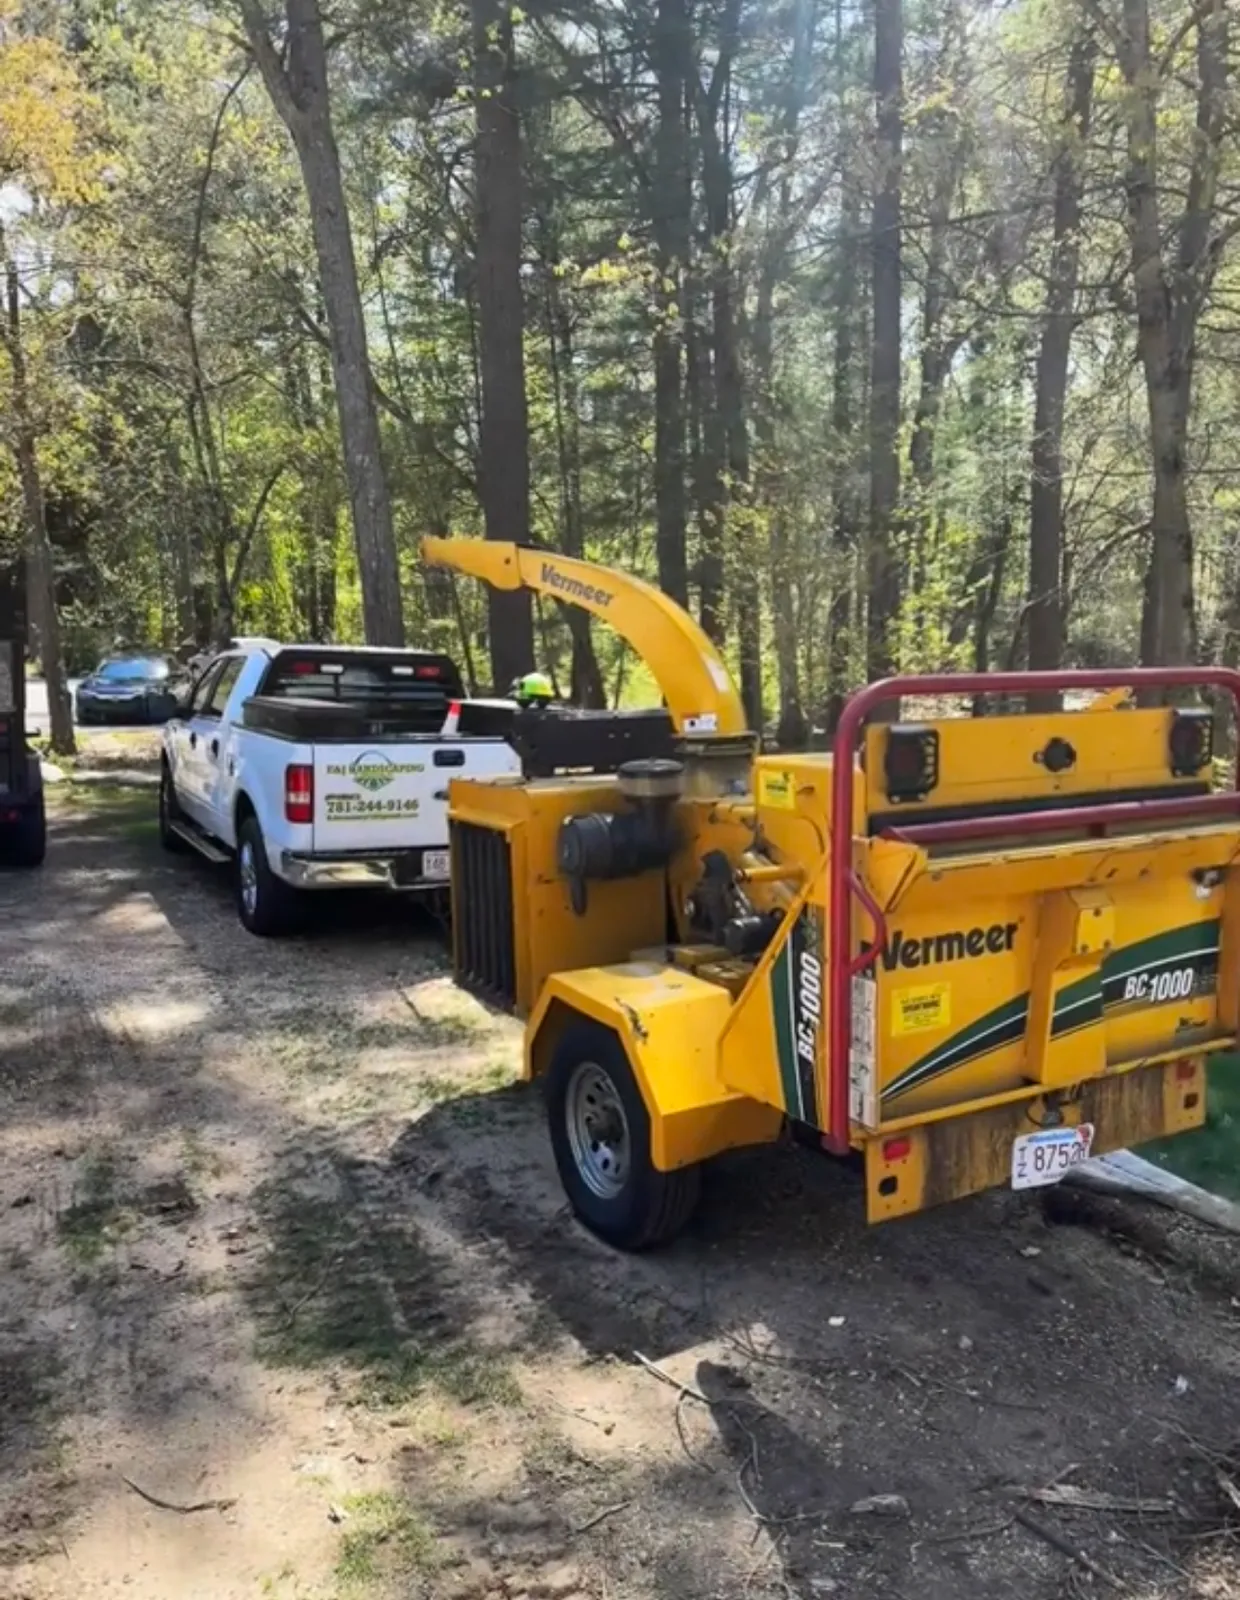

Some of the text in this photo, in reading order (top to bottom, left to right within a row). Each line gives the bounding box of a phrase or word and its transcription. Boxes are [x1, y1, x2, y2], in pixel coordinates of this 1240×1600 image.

[541, 563, 614, 607] Vermeer
[326, 798, 420, 814] 781-244-9146
[881, 923, 1018, 971] Vermeer
